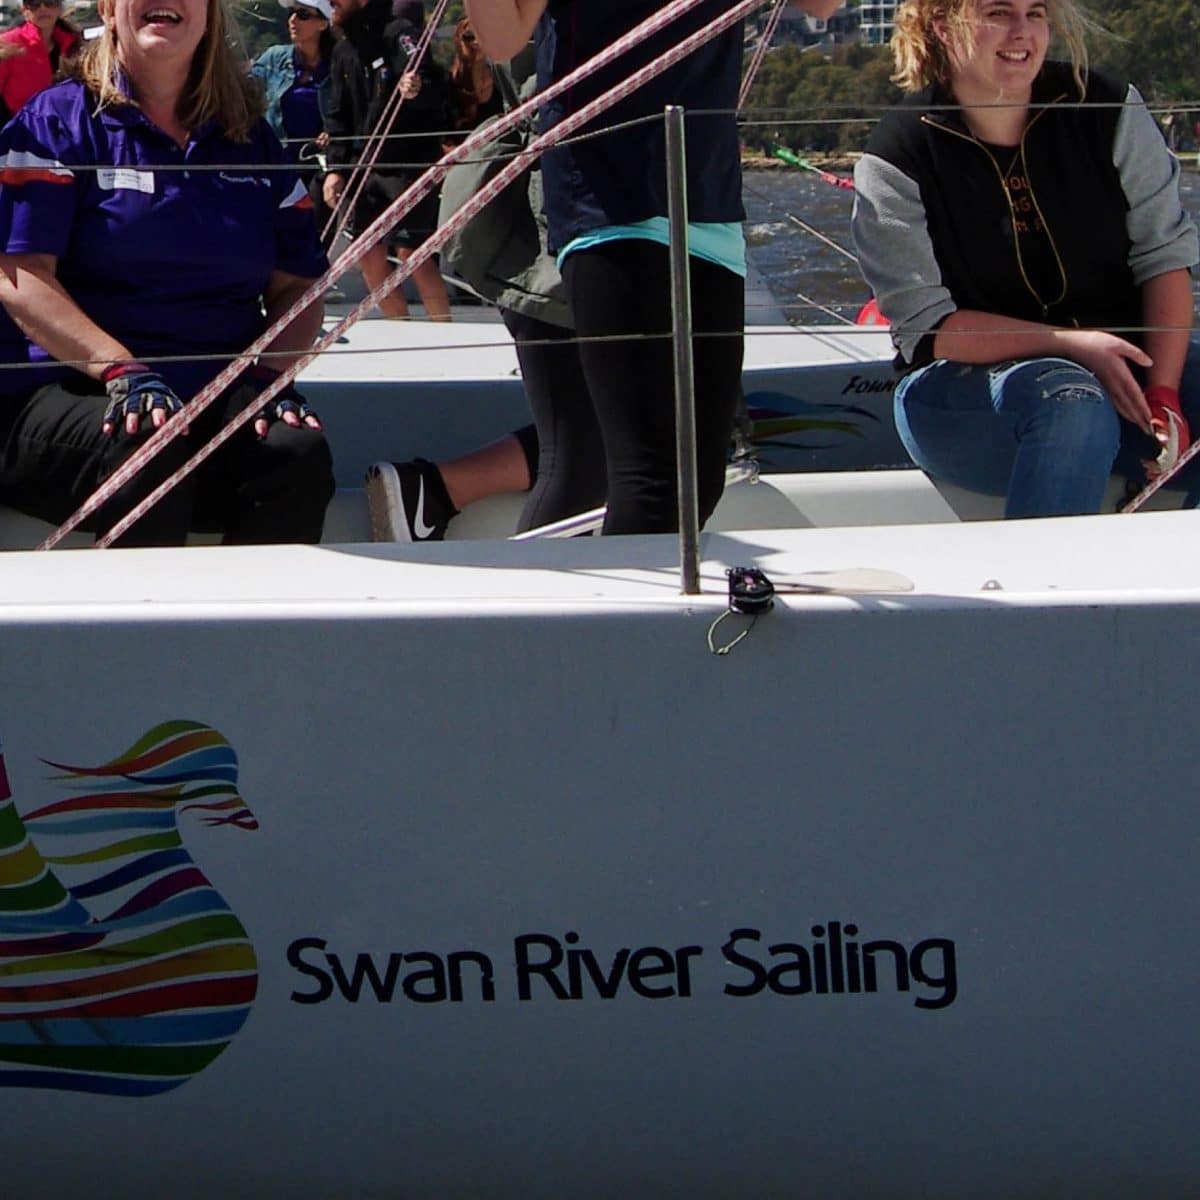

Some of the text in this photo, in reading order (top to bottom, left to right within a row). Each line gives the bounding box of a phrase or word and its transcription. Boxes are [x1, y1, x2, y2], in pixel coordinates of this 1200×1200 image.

[286, 920, 958, 1010] Swan River Sailing
